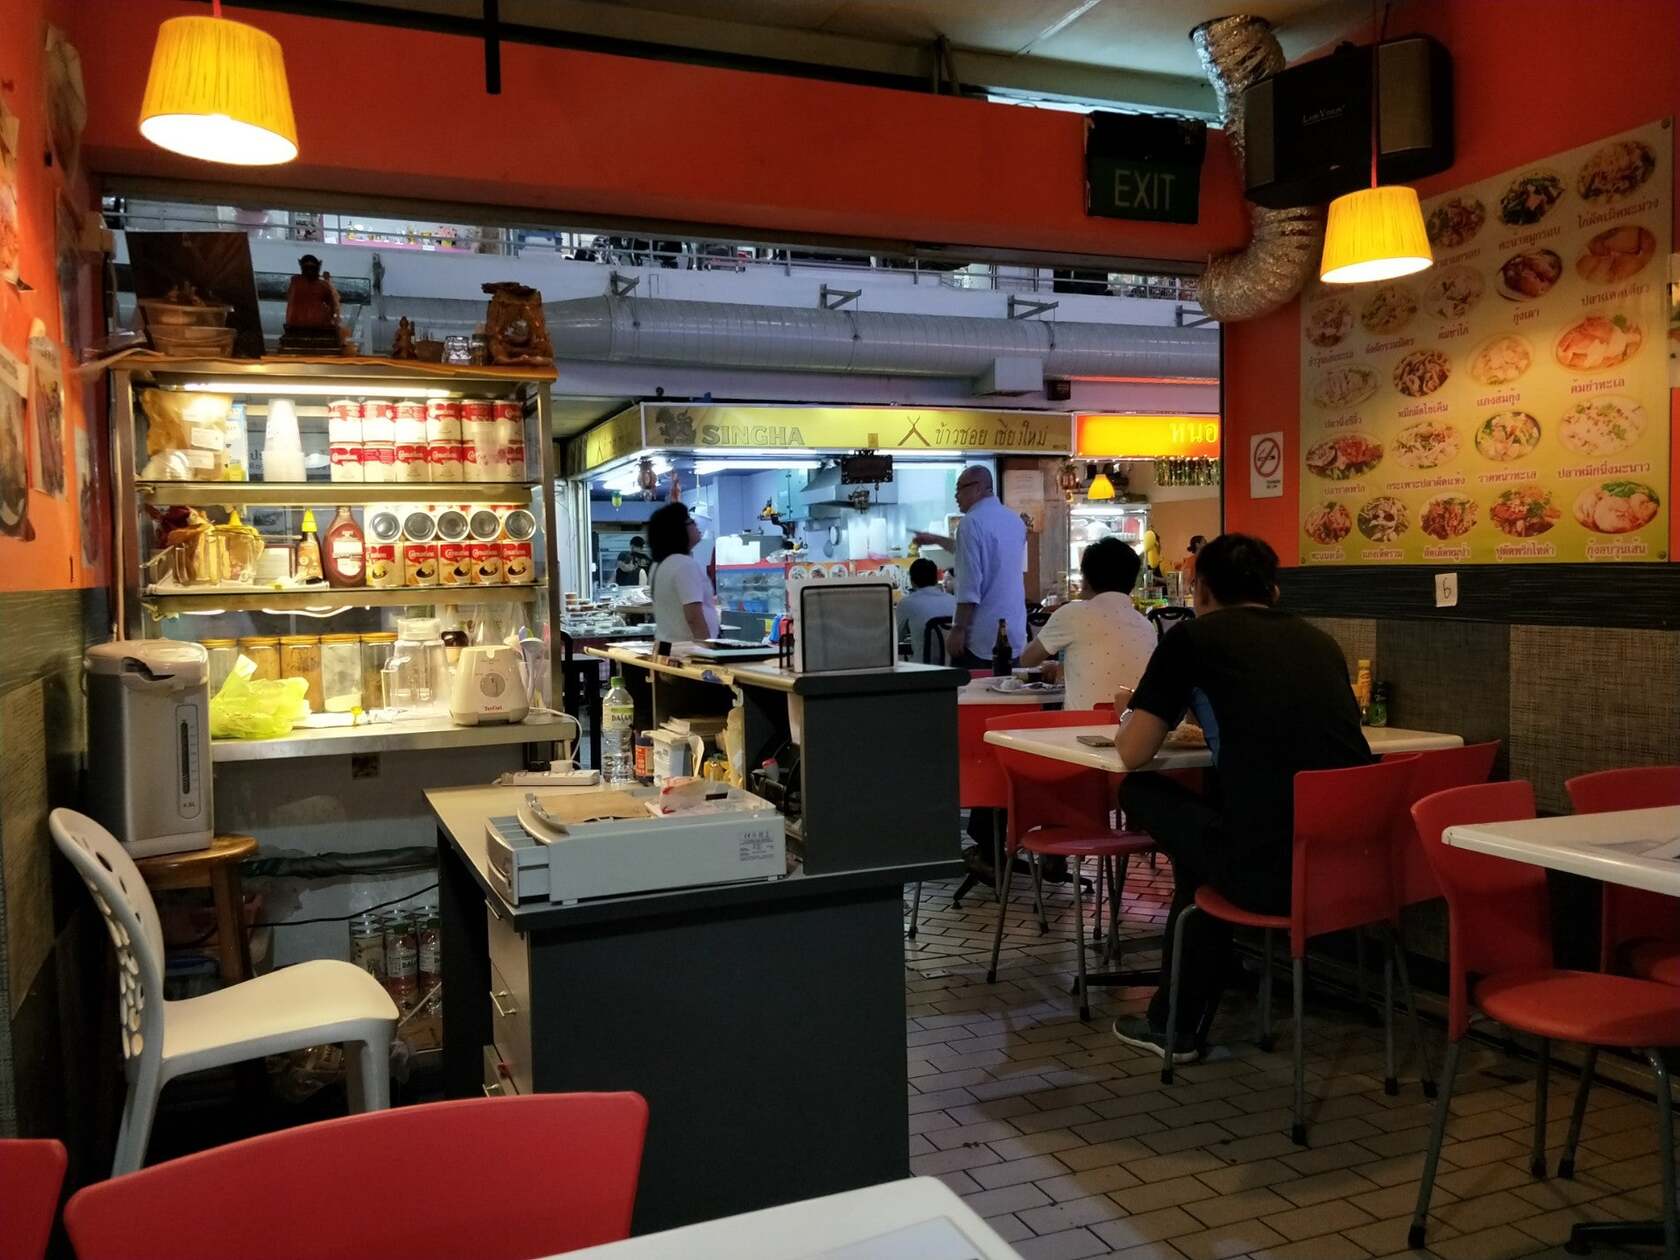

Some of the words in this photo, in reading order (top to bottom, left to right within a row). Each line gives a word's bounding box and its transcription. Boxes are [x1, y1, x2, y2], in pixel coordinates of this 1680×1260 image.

[1114, 168, 1176, 211] EXIT
[702, 424, 805, 446] SINGHA
[935, 422, 987, 446] ข้าวซอย
[994, 418, 1049, 447] เชียงใหม่
[1557, 460, 1651, 479] ปลาหมึกนึ่งมะนาว
[1587, 537, 1646, 560] กุ้งอบวุ้นเส้น
